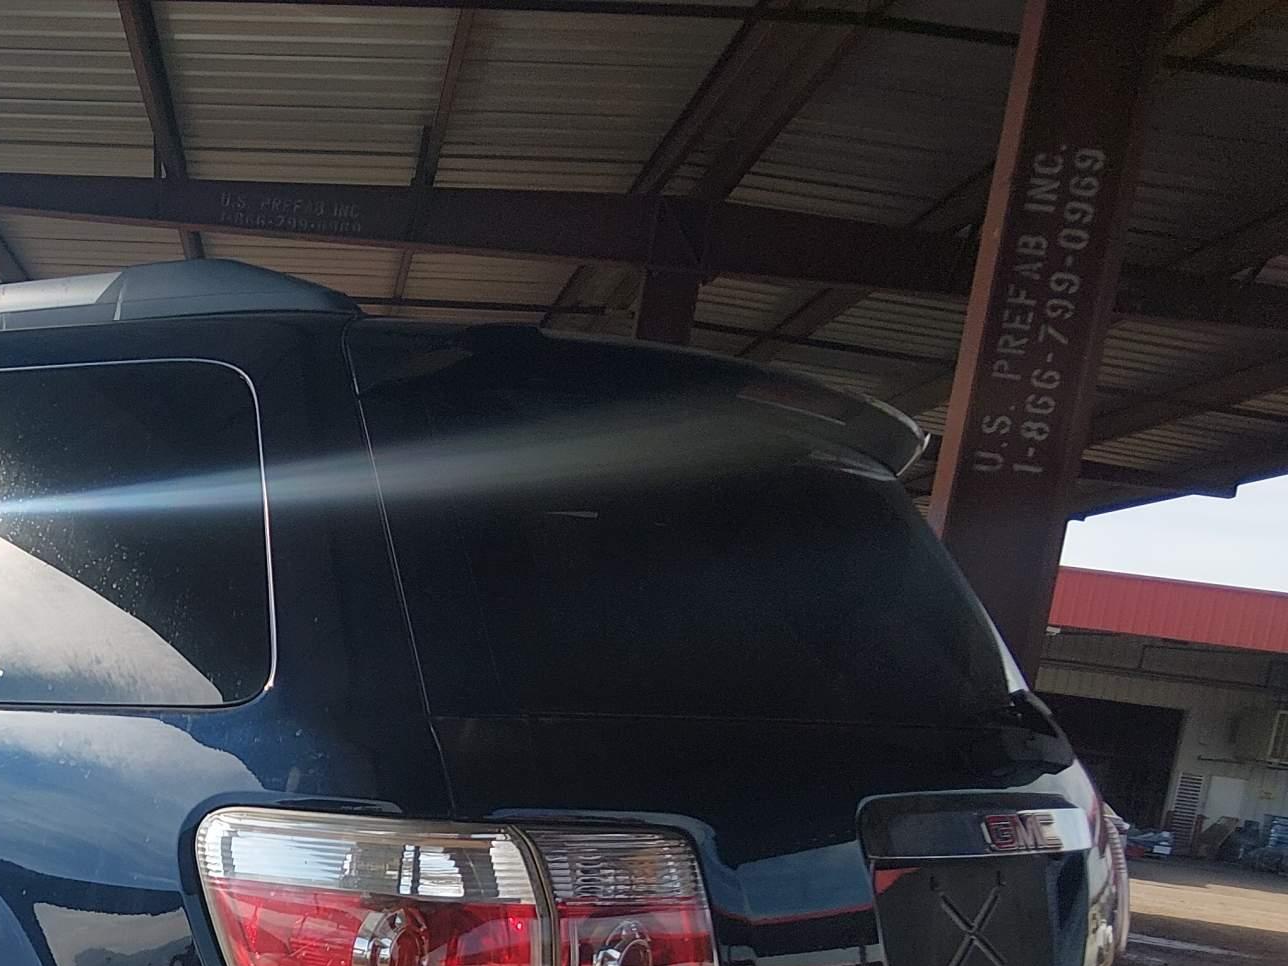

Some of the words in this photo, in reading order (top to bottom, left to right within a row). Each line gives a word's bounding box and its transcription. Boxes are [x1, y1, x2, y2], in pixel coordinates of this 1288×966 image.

[1024, 144, 1067, 213] INC.
[992, 234, 1049, 381] PREFAB
[1013, 148, 1106, 473] 1-866-799-0969
[973, 405, 1015, 472] U.S.
[981, 813, 1064, 852] GMC
